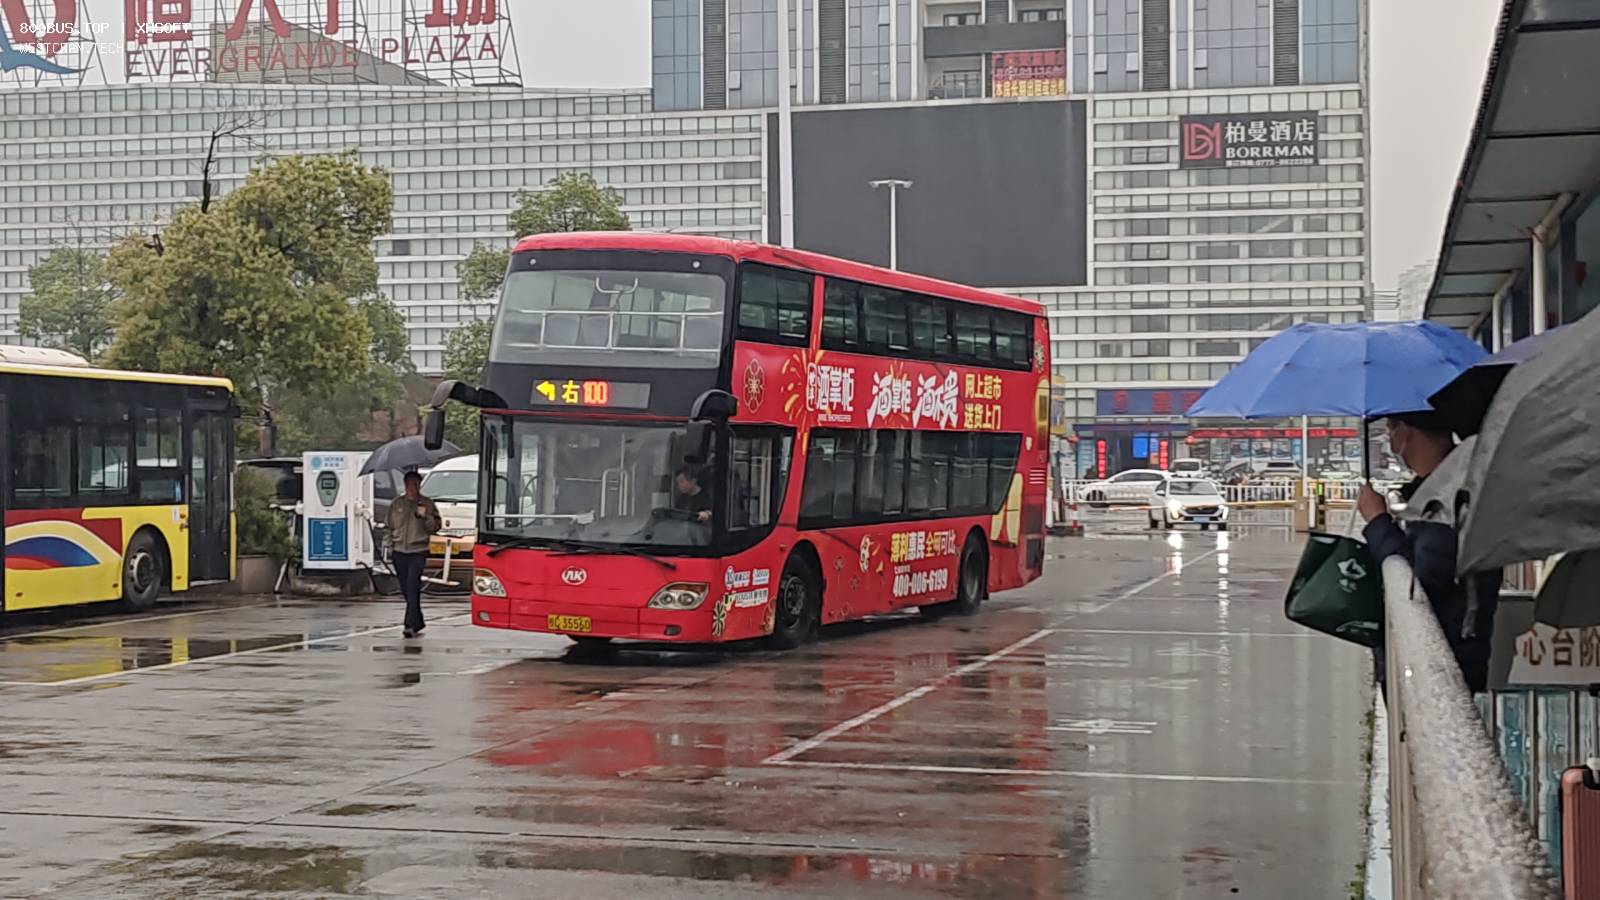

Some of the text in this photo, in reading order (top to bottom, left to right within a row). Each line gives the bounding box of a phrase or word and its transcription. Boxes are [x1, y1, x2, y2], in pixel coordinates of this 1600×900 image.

[127, 33, 498, 77] EVERGRANDE PLAZA
[1224, 119, 1316, 143] 柏曼酒店
[1225, 145, 1315, 159] BORRMAN
[964, 373, 1002, 401] 网上超市
[963, 402, 1002, 430] 送货上门
[892, 567, 949, 598] 400-006-6199
